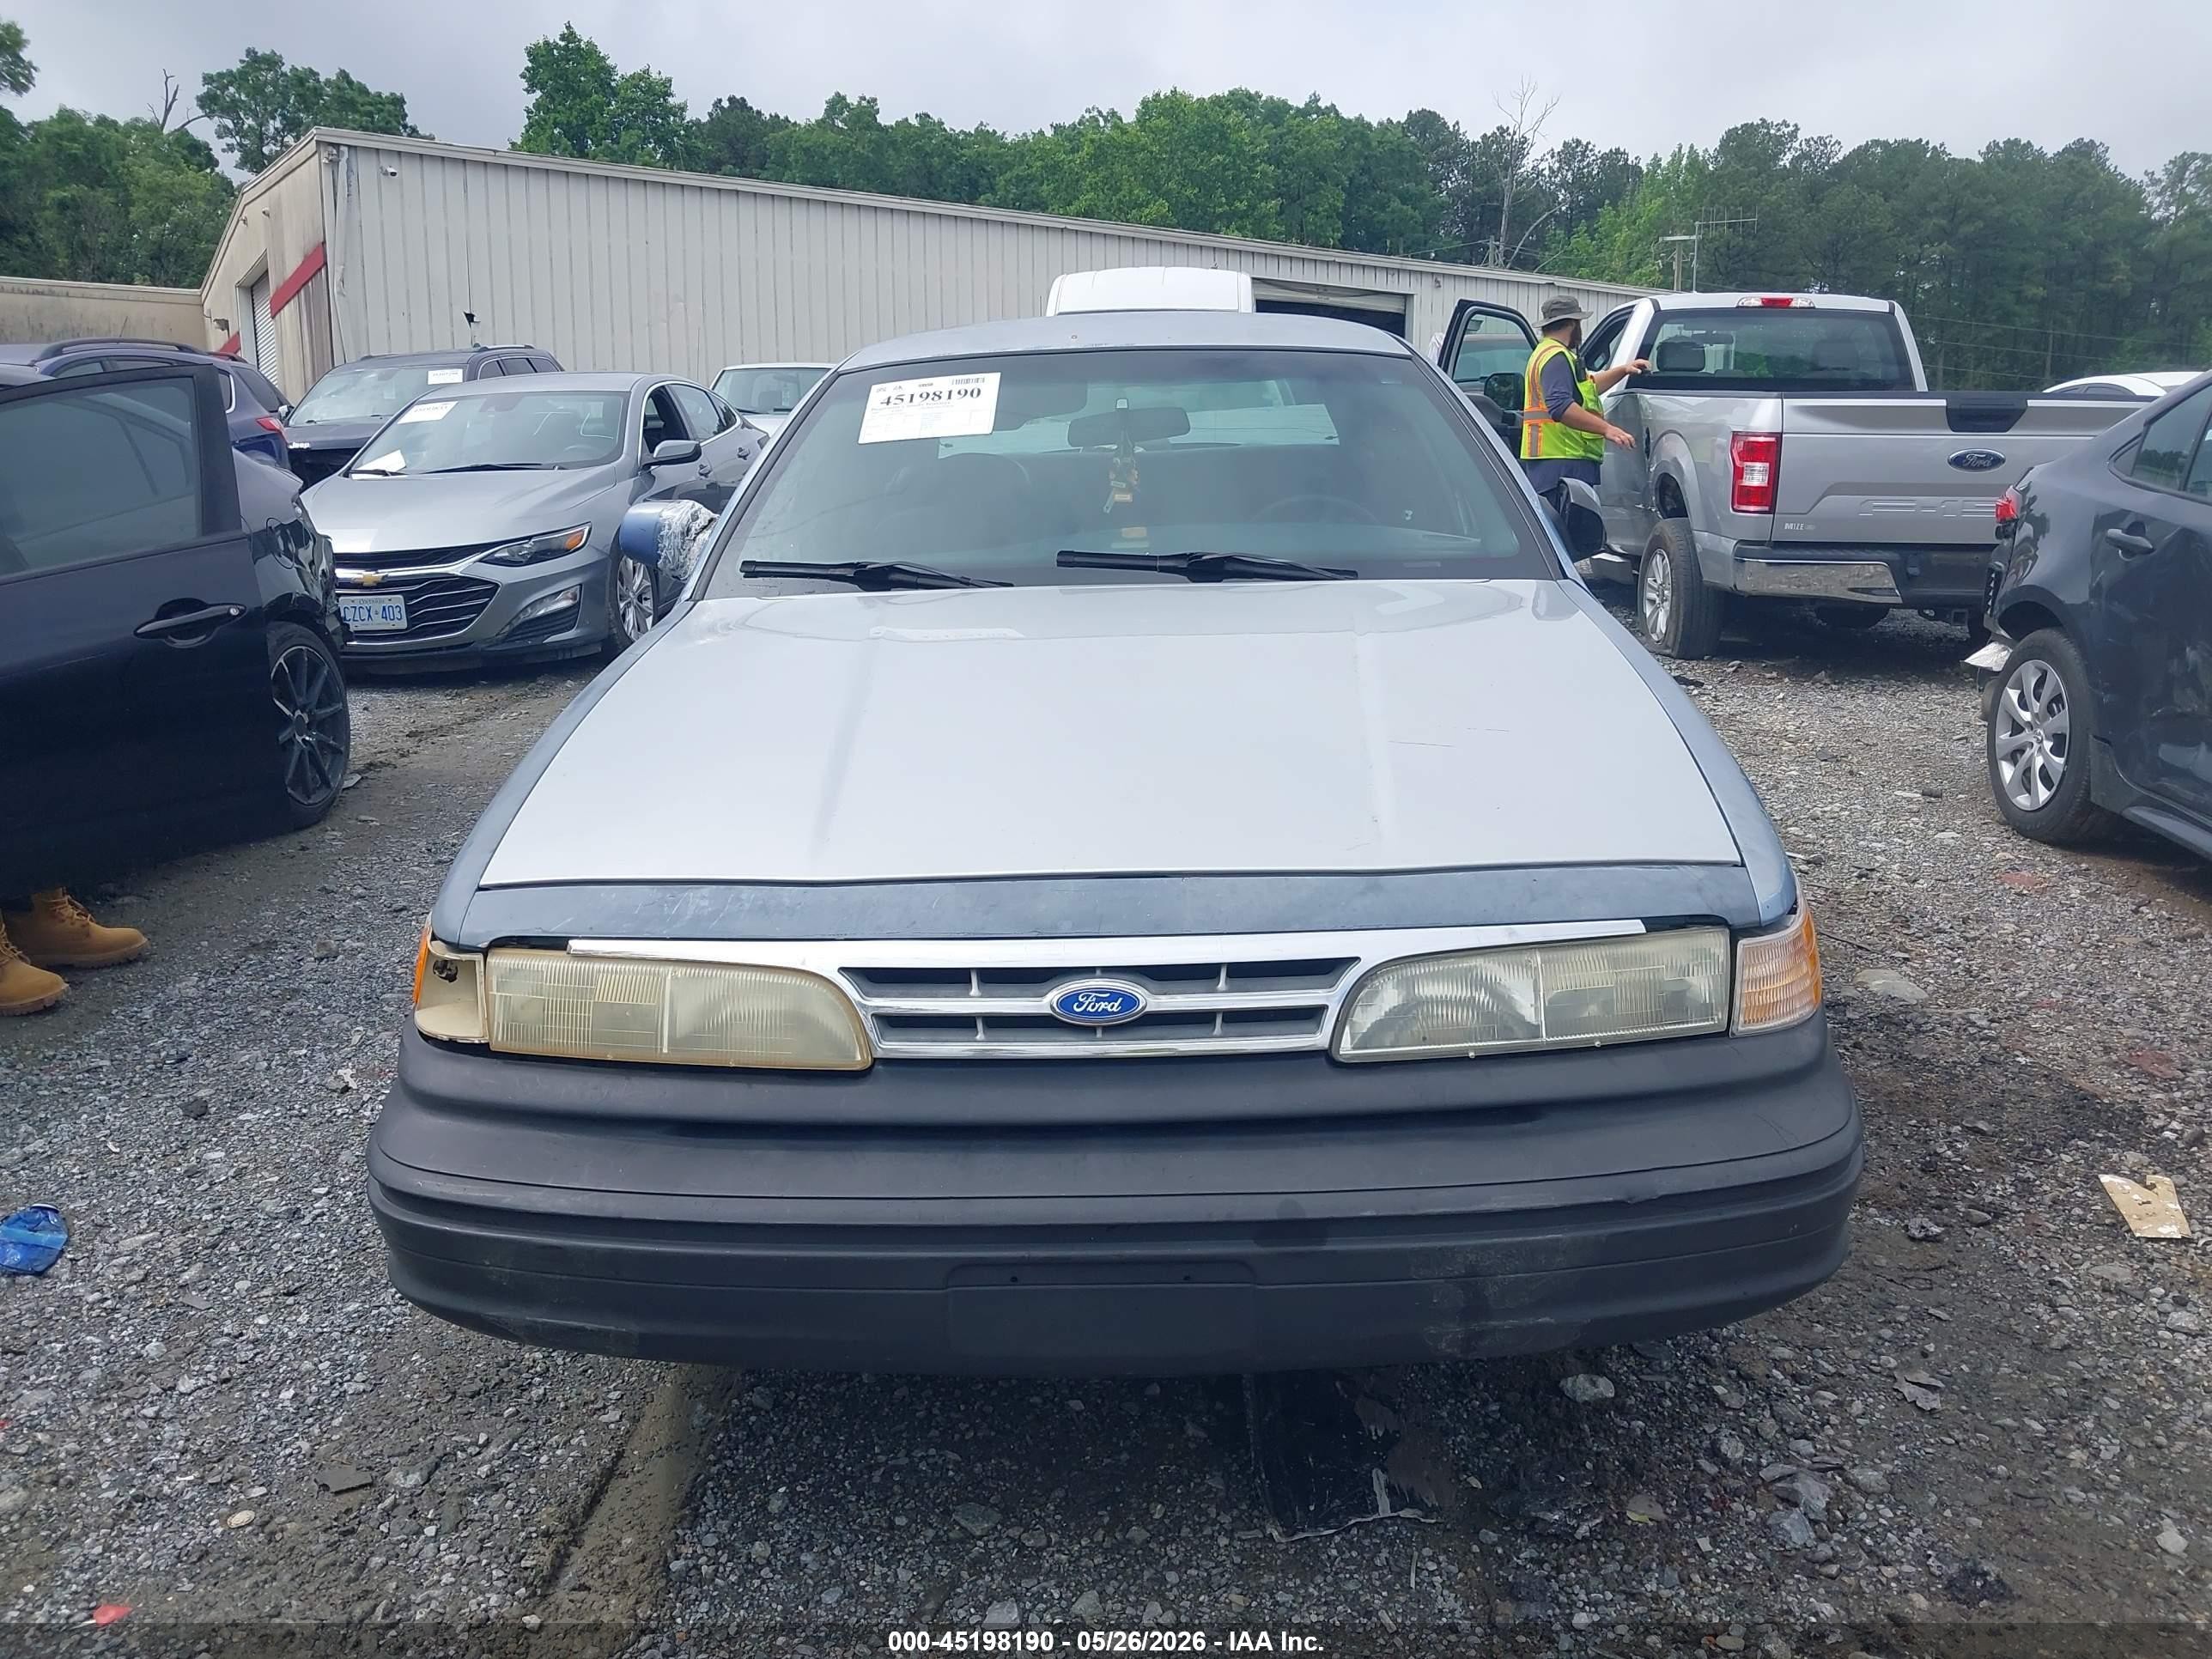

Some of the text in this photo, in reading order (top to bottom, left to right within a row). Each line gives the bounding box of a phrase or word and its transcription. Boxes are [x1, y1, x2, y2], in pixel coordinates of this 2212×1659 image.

[879, 387, 982, 406] 45198190
[1963, 453, 1994, 468] Ford
[1858, 499, 1997, 517] F-15
[343, 604, 403, 623] CZCX 403
[1073, 992, 1124, 1013] Ford
